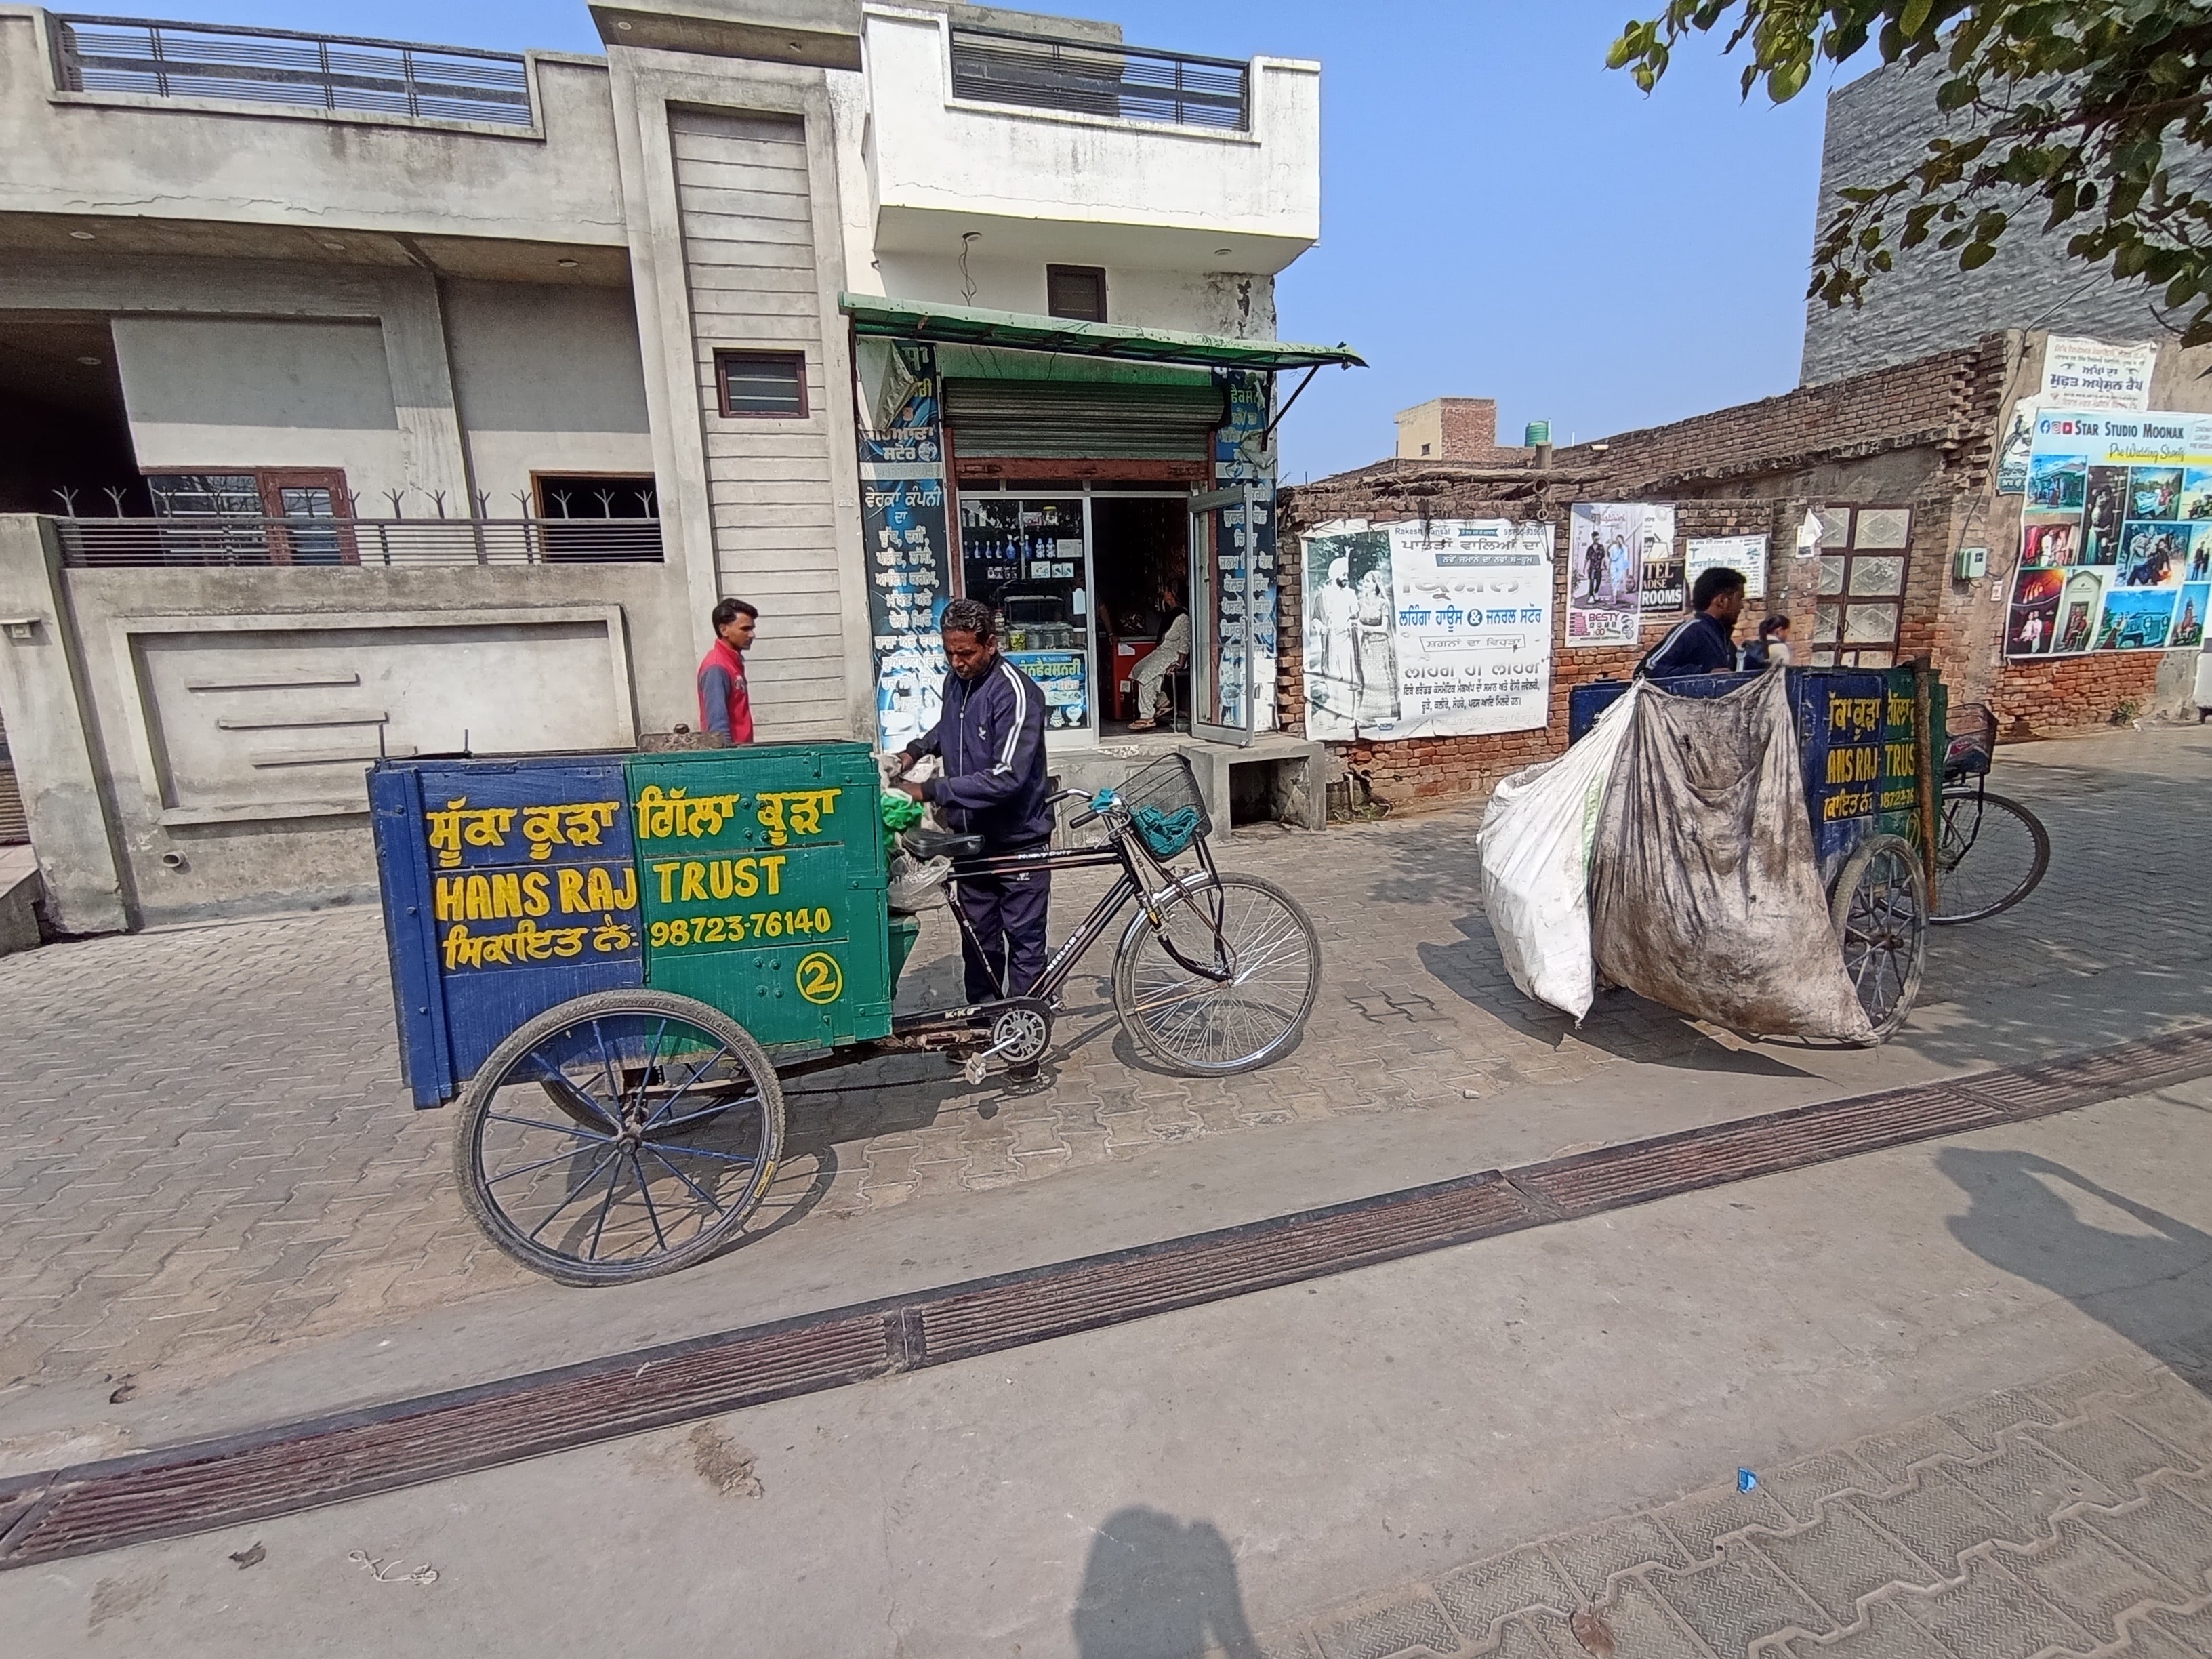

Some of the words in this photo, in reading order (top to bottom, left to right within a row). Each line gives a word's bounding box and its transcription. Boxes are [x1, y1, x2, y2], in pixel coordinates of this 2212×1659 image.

[2106, 368, 2118, 377] ਦਾ
[882, 443, 916, 461] ਸਟੋਰ
[865, 486, 901, 508] ਵੇਰਕਾ
[905, 485, 942, 508] ਕੰਪਨੀ
[894, 511, 908, 524] ਦਾ
[1522, 541, 1540, 550] ਦਾ
[1644, 562, 1675, 579] TEL
[1641, 588, 1683, 605] ROOMS
[1399, 604, 1432, 626] ਲਹਿੰਗਾ
[1435, 604, 1464, 632] ਹਾਊਸ
[1468, 609, 1483, 626] &
[1486, 609, 1517, 624] ਜਨਰਲ
[1520, 602, 1542, 623] ਸਟੋਰ
[1826, 748, 1853, 785] ANS
[1856, 747, 1879, 781] RAJ
[1885, 744, 1916, 777] TRUS
[523, 801, 620, 860] ਕੂੜਾ
[636, 785, 741, 839] ਗਿੱਲਾ
[755, 788, 842, 846] ਕੂੜਾ
[436, 871, 551, 922] HANS
[556, 867, 638, 913] RAJ
[651, 855, 786, 904] TRUST
[650, 907, 832, 948] 98723-76140
